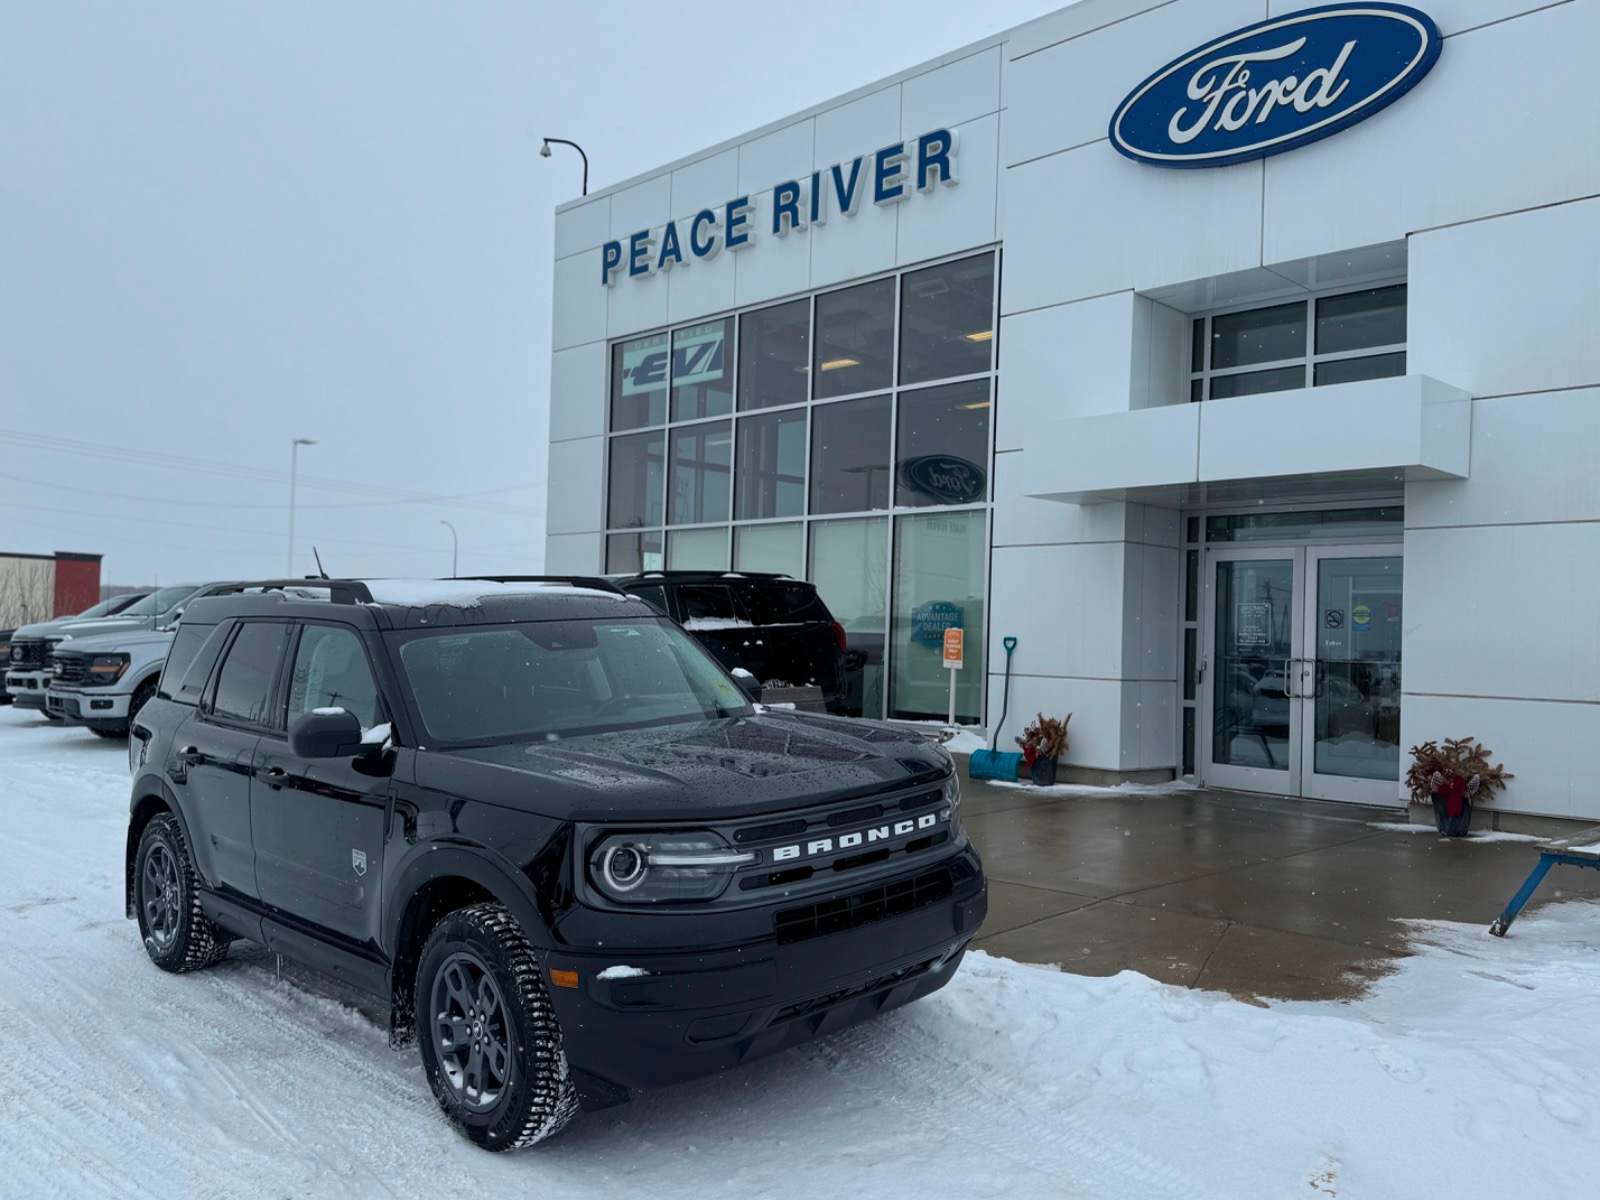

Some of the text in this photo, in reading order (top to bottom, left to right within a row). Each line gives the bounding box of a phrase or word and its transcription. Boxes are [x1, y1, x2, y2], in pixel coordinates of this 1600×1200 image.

[1168, 36, 1357, 144] Ford
[602, 127, 955, 286] PEACE RIVER
[773, 813, 937, 861] BRONCO
